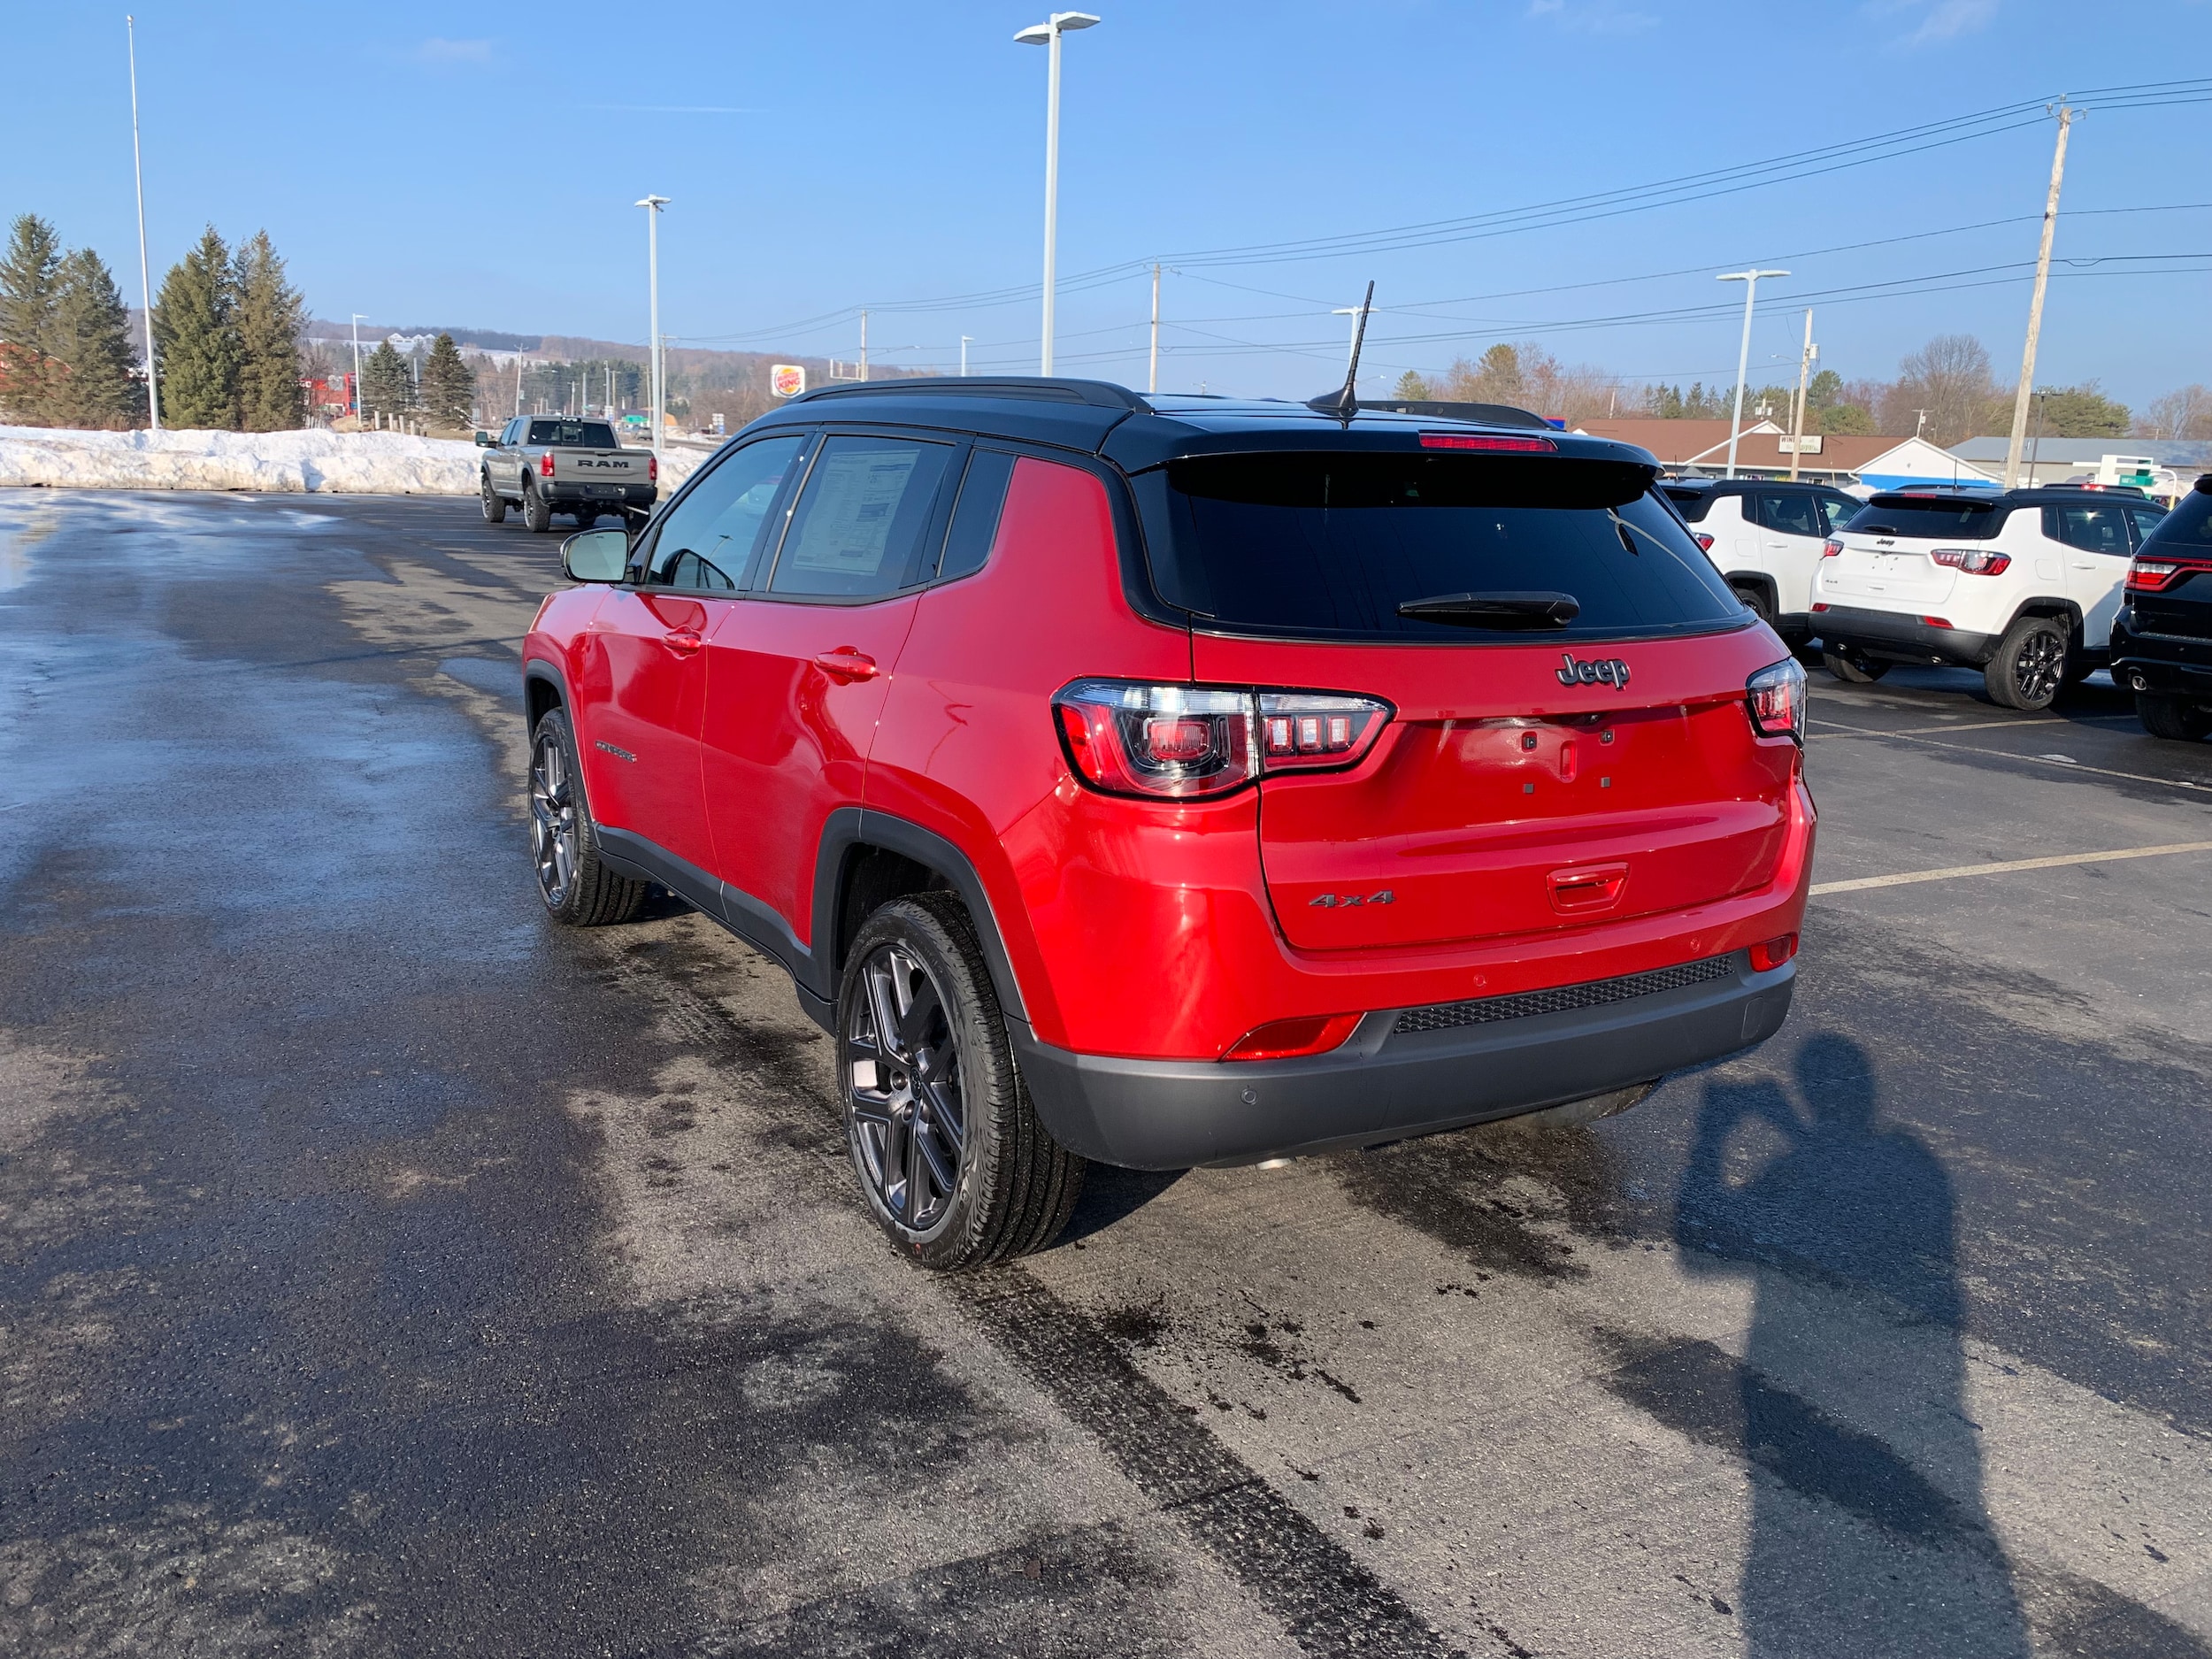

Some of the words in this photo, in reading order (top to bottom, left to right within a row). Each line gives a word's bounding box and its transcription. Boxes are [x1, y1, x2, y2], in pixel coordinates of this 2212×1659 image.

[779, 378, 801, 389] KING
[578, 459, 628, 468] RAM
[1555, 653, 1632, 691] Jeep
[1309, 889, 1396, 908] 4x4
